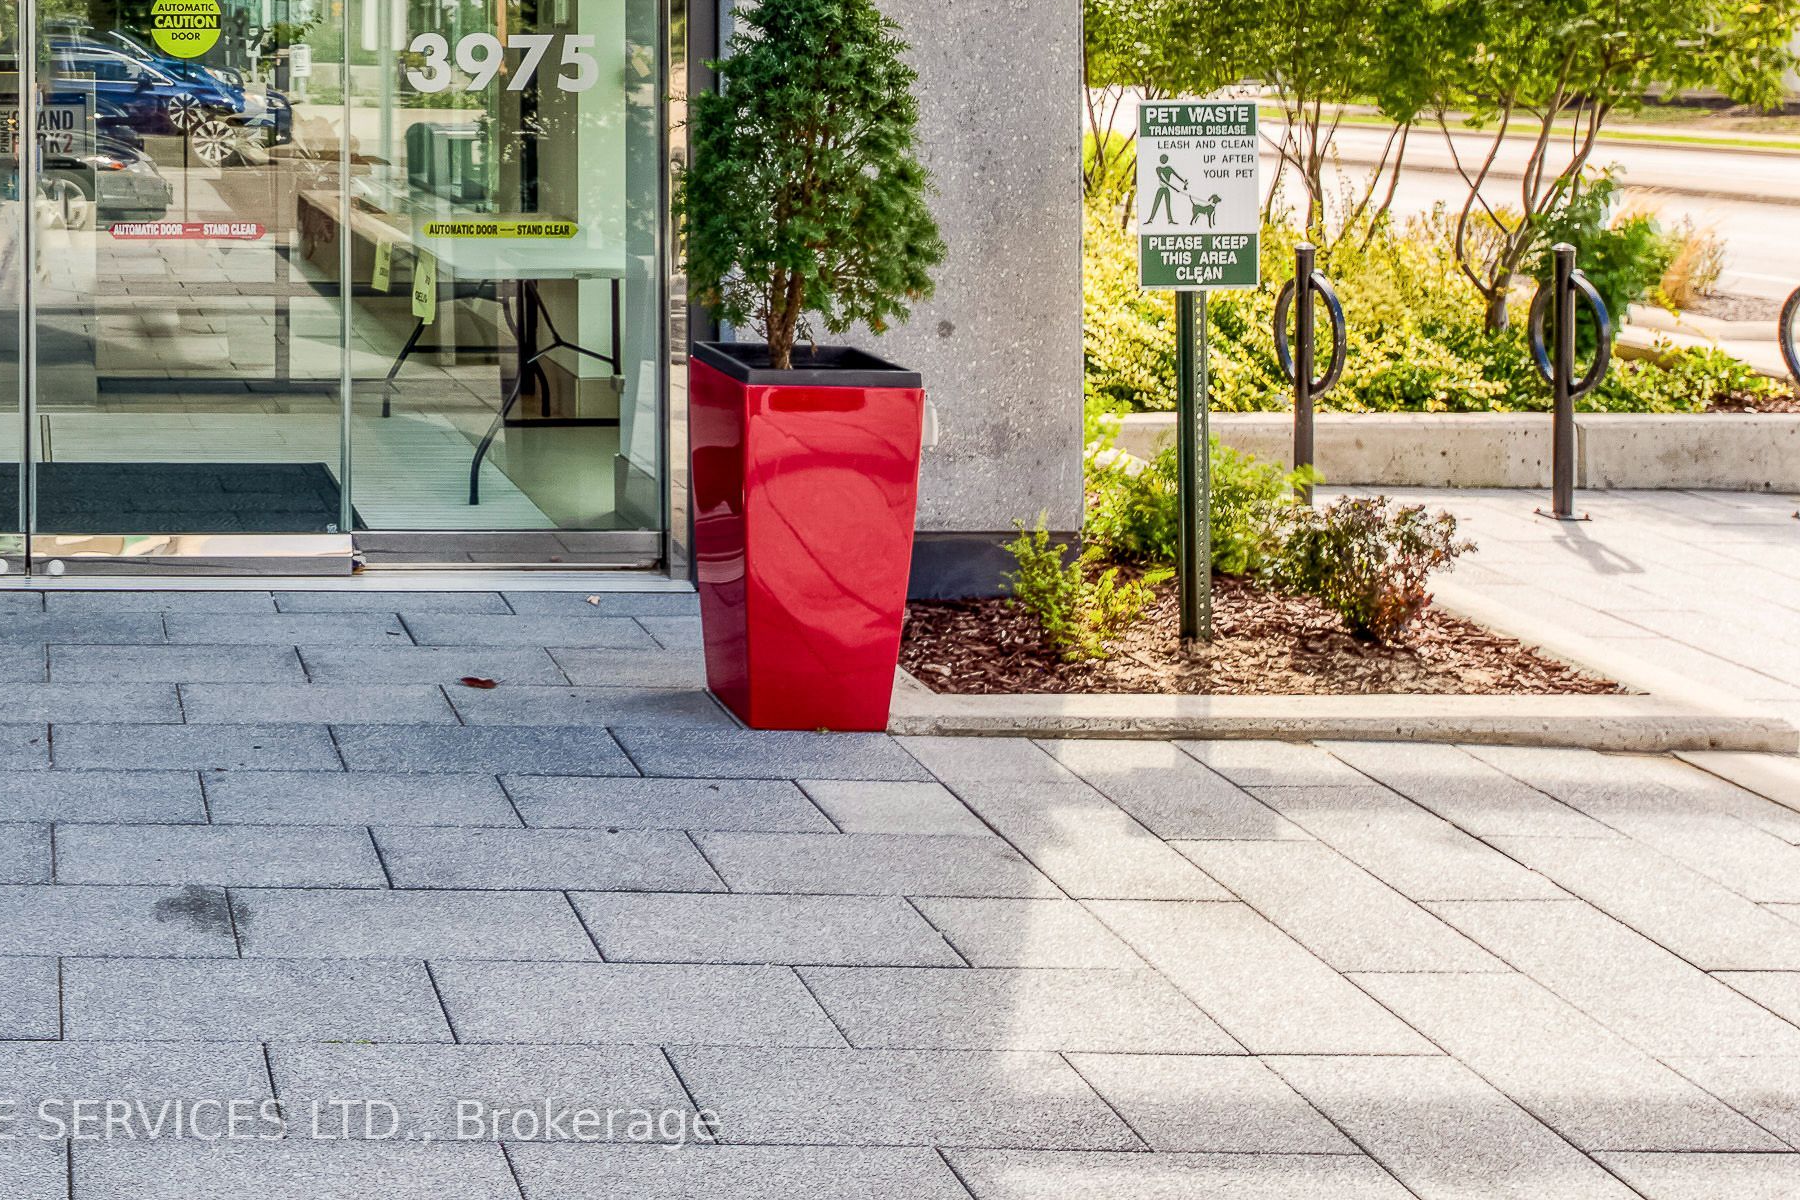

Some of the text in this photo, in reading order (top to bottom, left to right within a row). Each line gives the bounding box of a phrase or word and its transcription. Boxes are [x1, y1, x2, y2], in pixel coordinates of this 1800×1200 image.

[158, 3, 214, 12] AUTOMATIC
[154, 15, 217, 29] CAUTION
[171, 32, 201, 41] DOOR
[406, 32, 600, 93] 3975
[1146, 105, 1249, 124] PET WASTE
[1149, 124, 1247, 136] TRANSMITS DISEASE
[1157, 139, 1254, 149] LEASH AND CLEAN
[1203, 154, 1254, 164] UP AFTER
[1203, 168, 1254, 178] YOUR PET
[113, 223, 257, 235] AUTOMATIC DOOR STAND CLEAR
[429, 224, 570, 235] AUTOMATIC DOOR STAND CLEAR
[1148, 235, 1249, 250] PLEASE KEEP
[1160, 251, 1238, 265] THIS AREA
[1176, 266, 1223, 281] CLEAN
